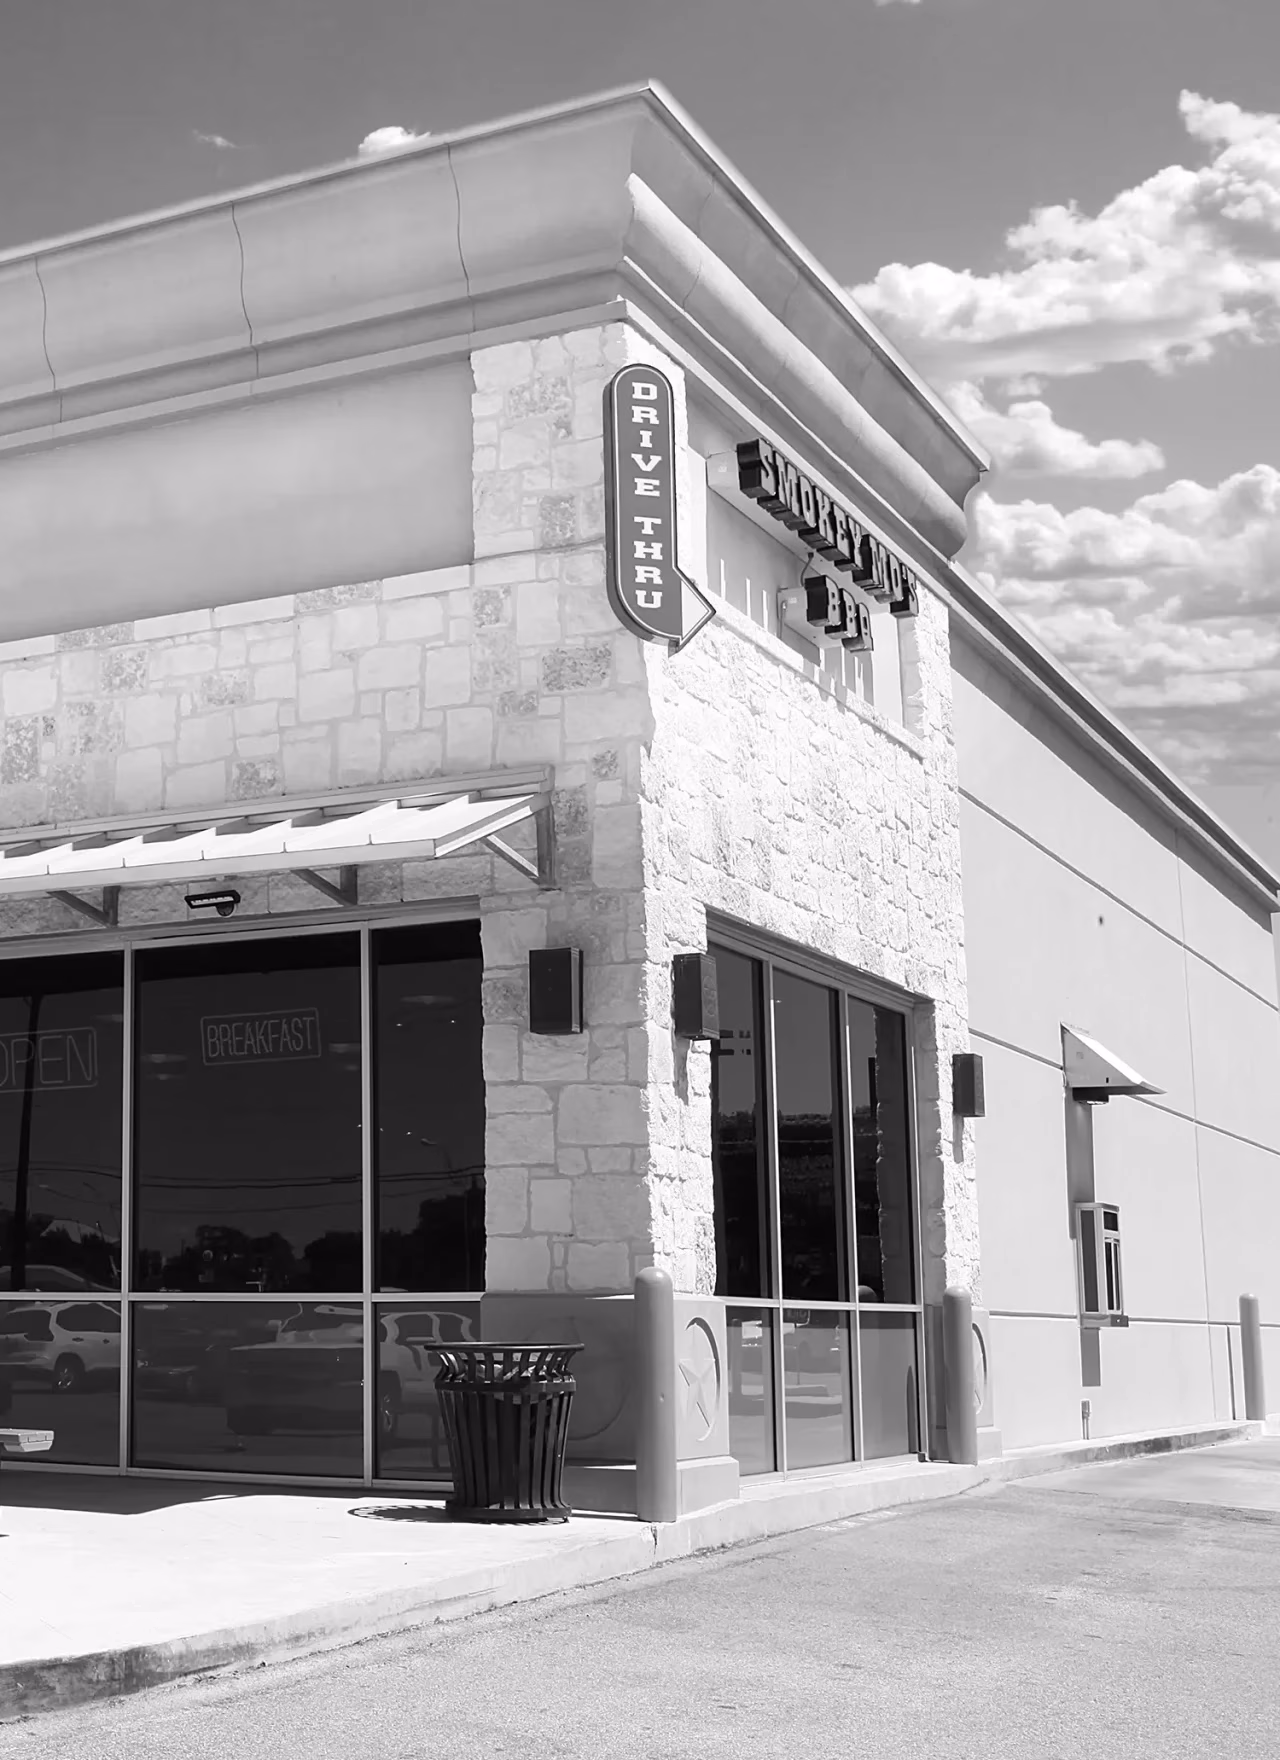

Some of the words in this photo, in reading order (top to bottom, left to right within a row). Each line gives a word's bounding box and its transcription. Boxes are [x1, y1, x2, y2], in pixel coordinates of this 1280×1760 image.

[631, 381, 662, 498] DRIVE
[740, 438, 866, 571] SMOKEY
[633, 516, 663, 610] THRU
[207, 1016, 315, 1058] BREAKFAST
